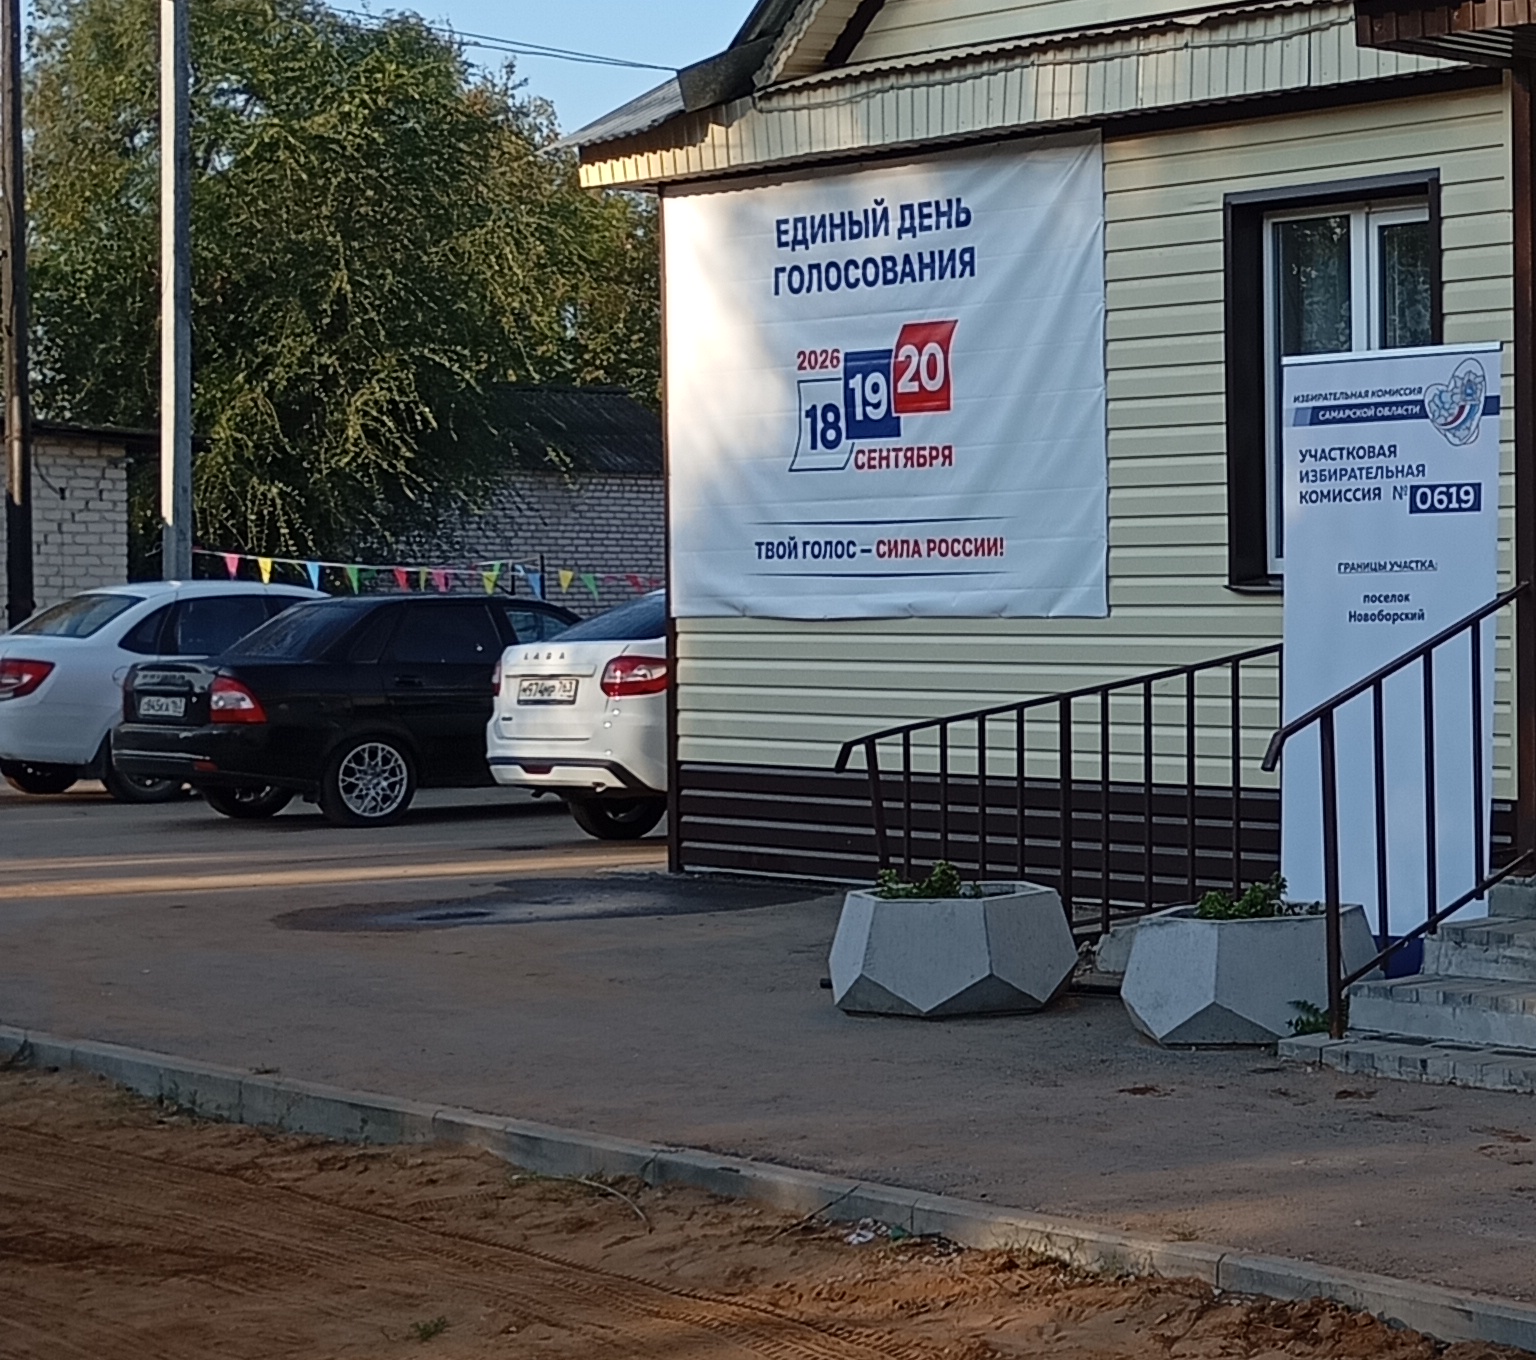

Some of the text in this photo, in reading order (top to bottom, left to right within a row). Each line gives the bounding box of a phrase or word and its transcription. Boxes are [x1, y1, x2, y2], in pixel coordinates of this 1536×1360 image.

[776, 197, 972, 251] ЕДИНЫЙ ДЕНЬ
[773, 246, 976, 296] ГОЛОСОВАНИЯ
[796, 348, 841, 371] 2026
[804, 344, 945, 450] 18 19 20
[1293, 387, 1423, 403] ИЗБИРАТЕЛЬНАЯ КОМИССИЯ
[1318, 405, 1421, 420] САМАРСКОЙ ОБЛАСТИ
[854, 445, 953, 470] СЕНТЯБРЯ
[1299, 444, 1397, 463] УЧАСТКОВАЯ
[1299, 464, 1426, 483] ИЗБИРАТЕЛЬНАЯ
[1299, 485, 1475, 510] КОМИССИЯ № 0619
[755, 536, 798, 560] ТВОЙ
[802, 539, 857, 560] ГОЛОС
[876, 538, 922, 559] СИЛА
[927, 537, 1004, 559] РОССИИ!
[1338, 559, 1438, 573] ГРАНИЦЫ УЧАСТКА:
[1363, 593, 1410, 604] поселок
[1348, 609, 1425, 624] Новоборский
[524, 652, 565, 660] LADA
